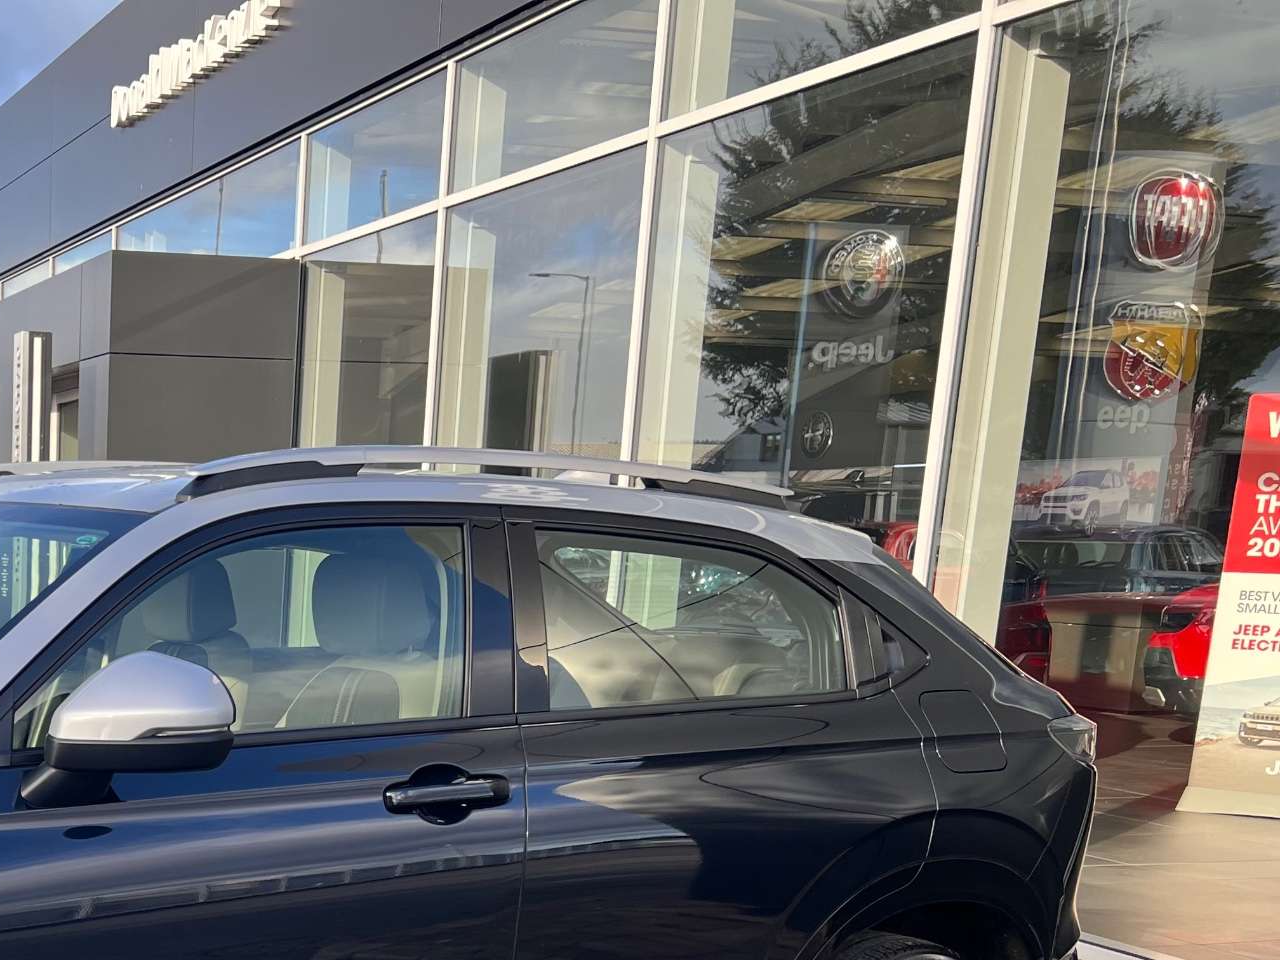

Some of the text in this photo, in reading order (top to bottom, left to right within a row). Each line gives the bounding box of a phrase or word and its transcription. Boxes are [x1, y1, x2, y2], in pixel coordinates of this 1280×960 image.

[1097, 403, 1150, 433] eep
[1239, 590, 1271, 602] BEST
[1236, 602, 1280, 615] SMALL
[1232, 623, 1271, 637] JEEP
[1231, 638, 1280, 653] ELECT
